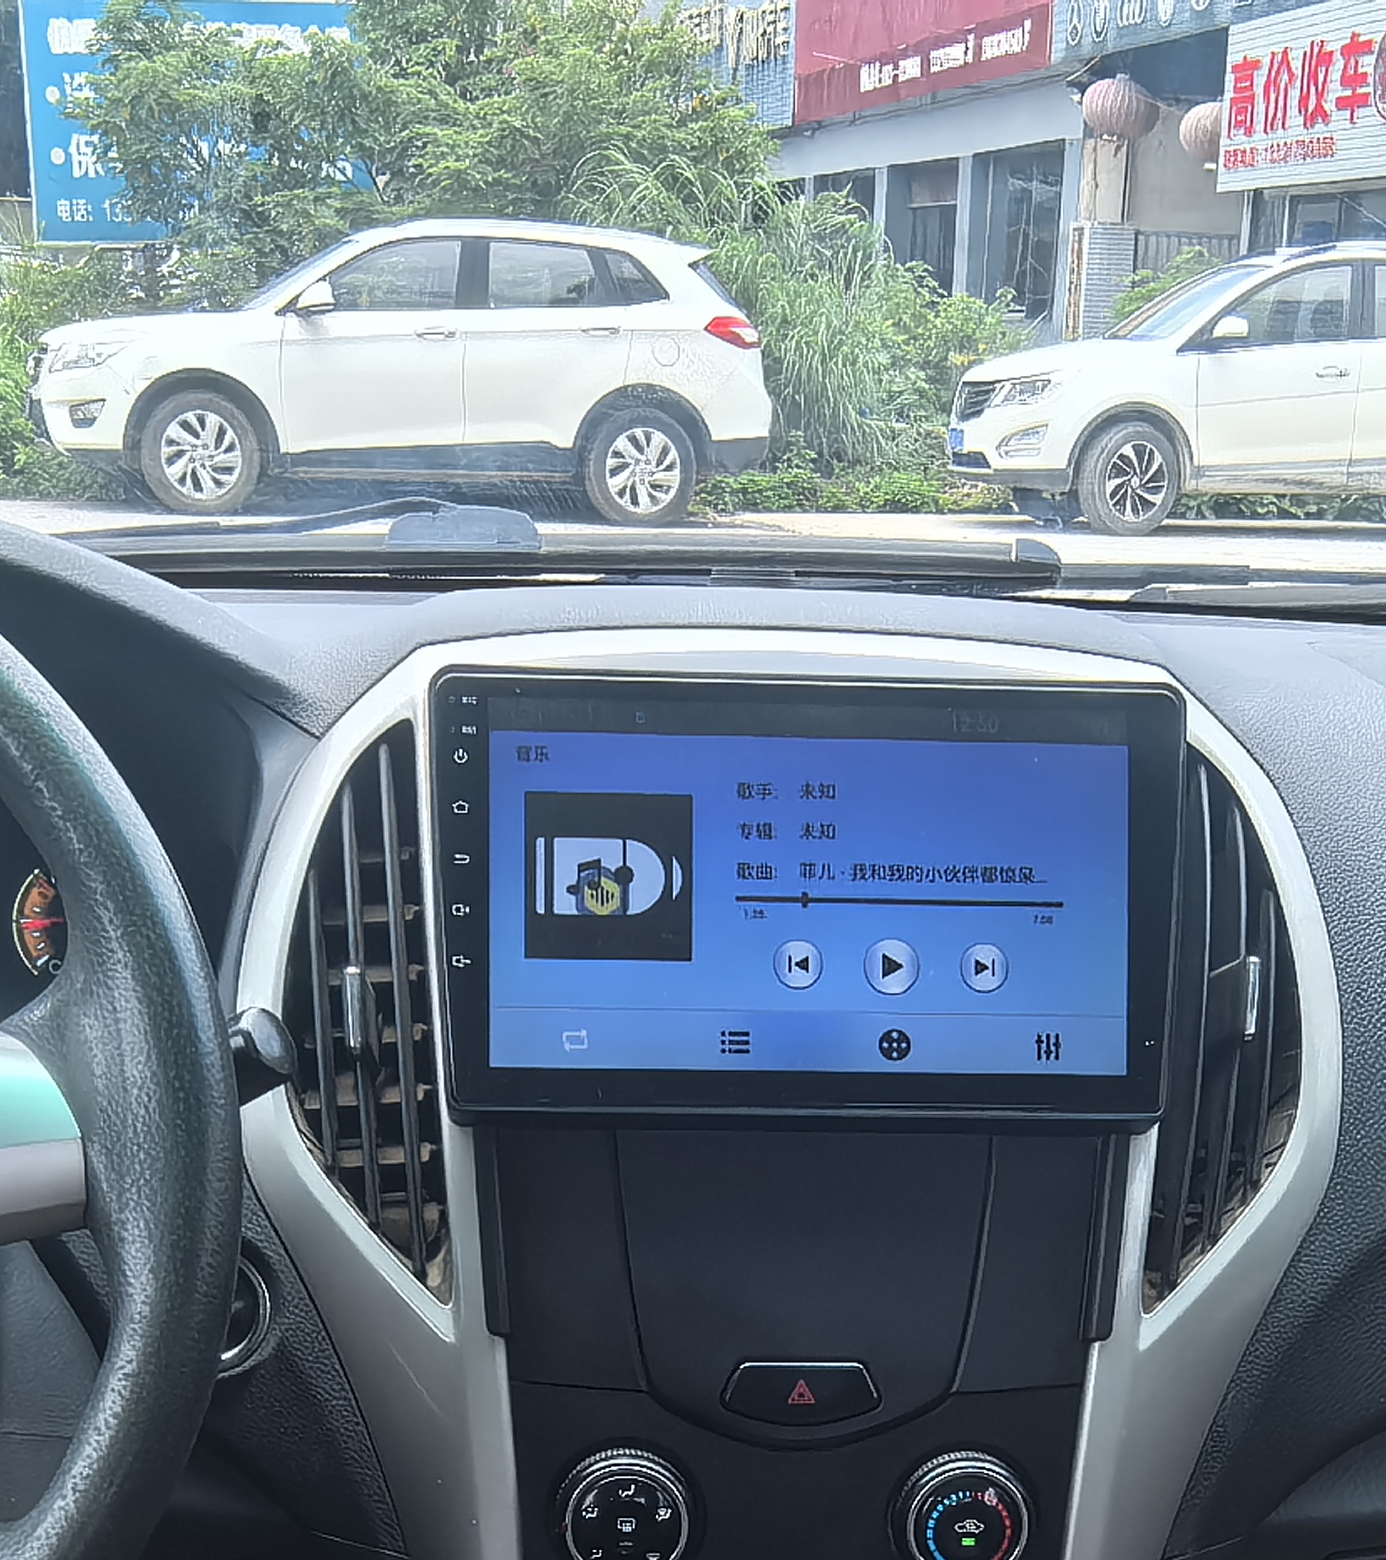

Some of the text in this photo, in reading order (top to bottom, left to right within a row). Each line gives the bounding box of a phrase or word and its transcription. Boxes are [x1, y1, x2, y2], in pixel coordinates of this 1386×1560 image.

[1227, 31, 1378, 140] 高价收车
[49, 959, 62, 975] C
